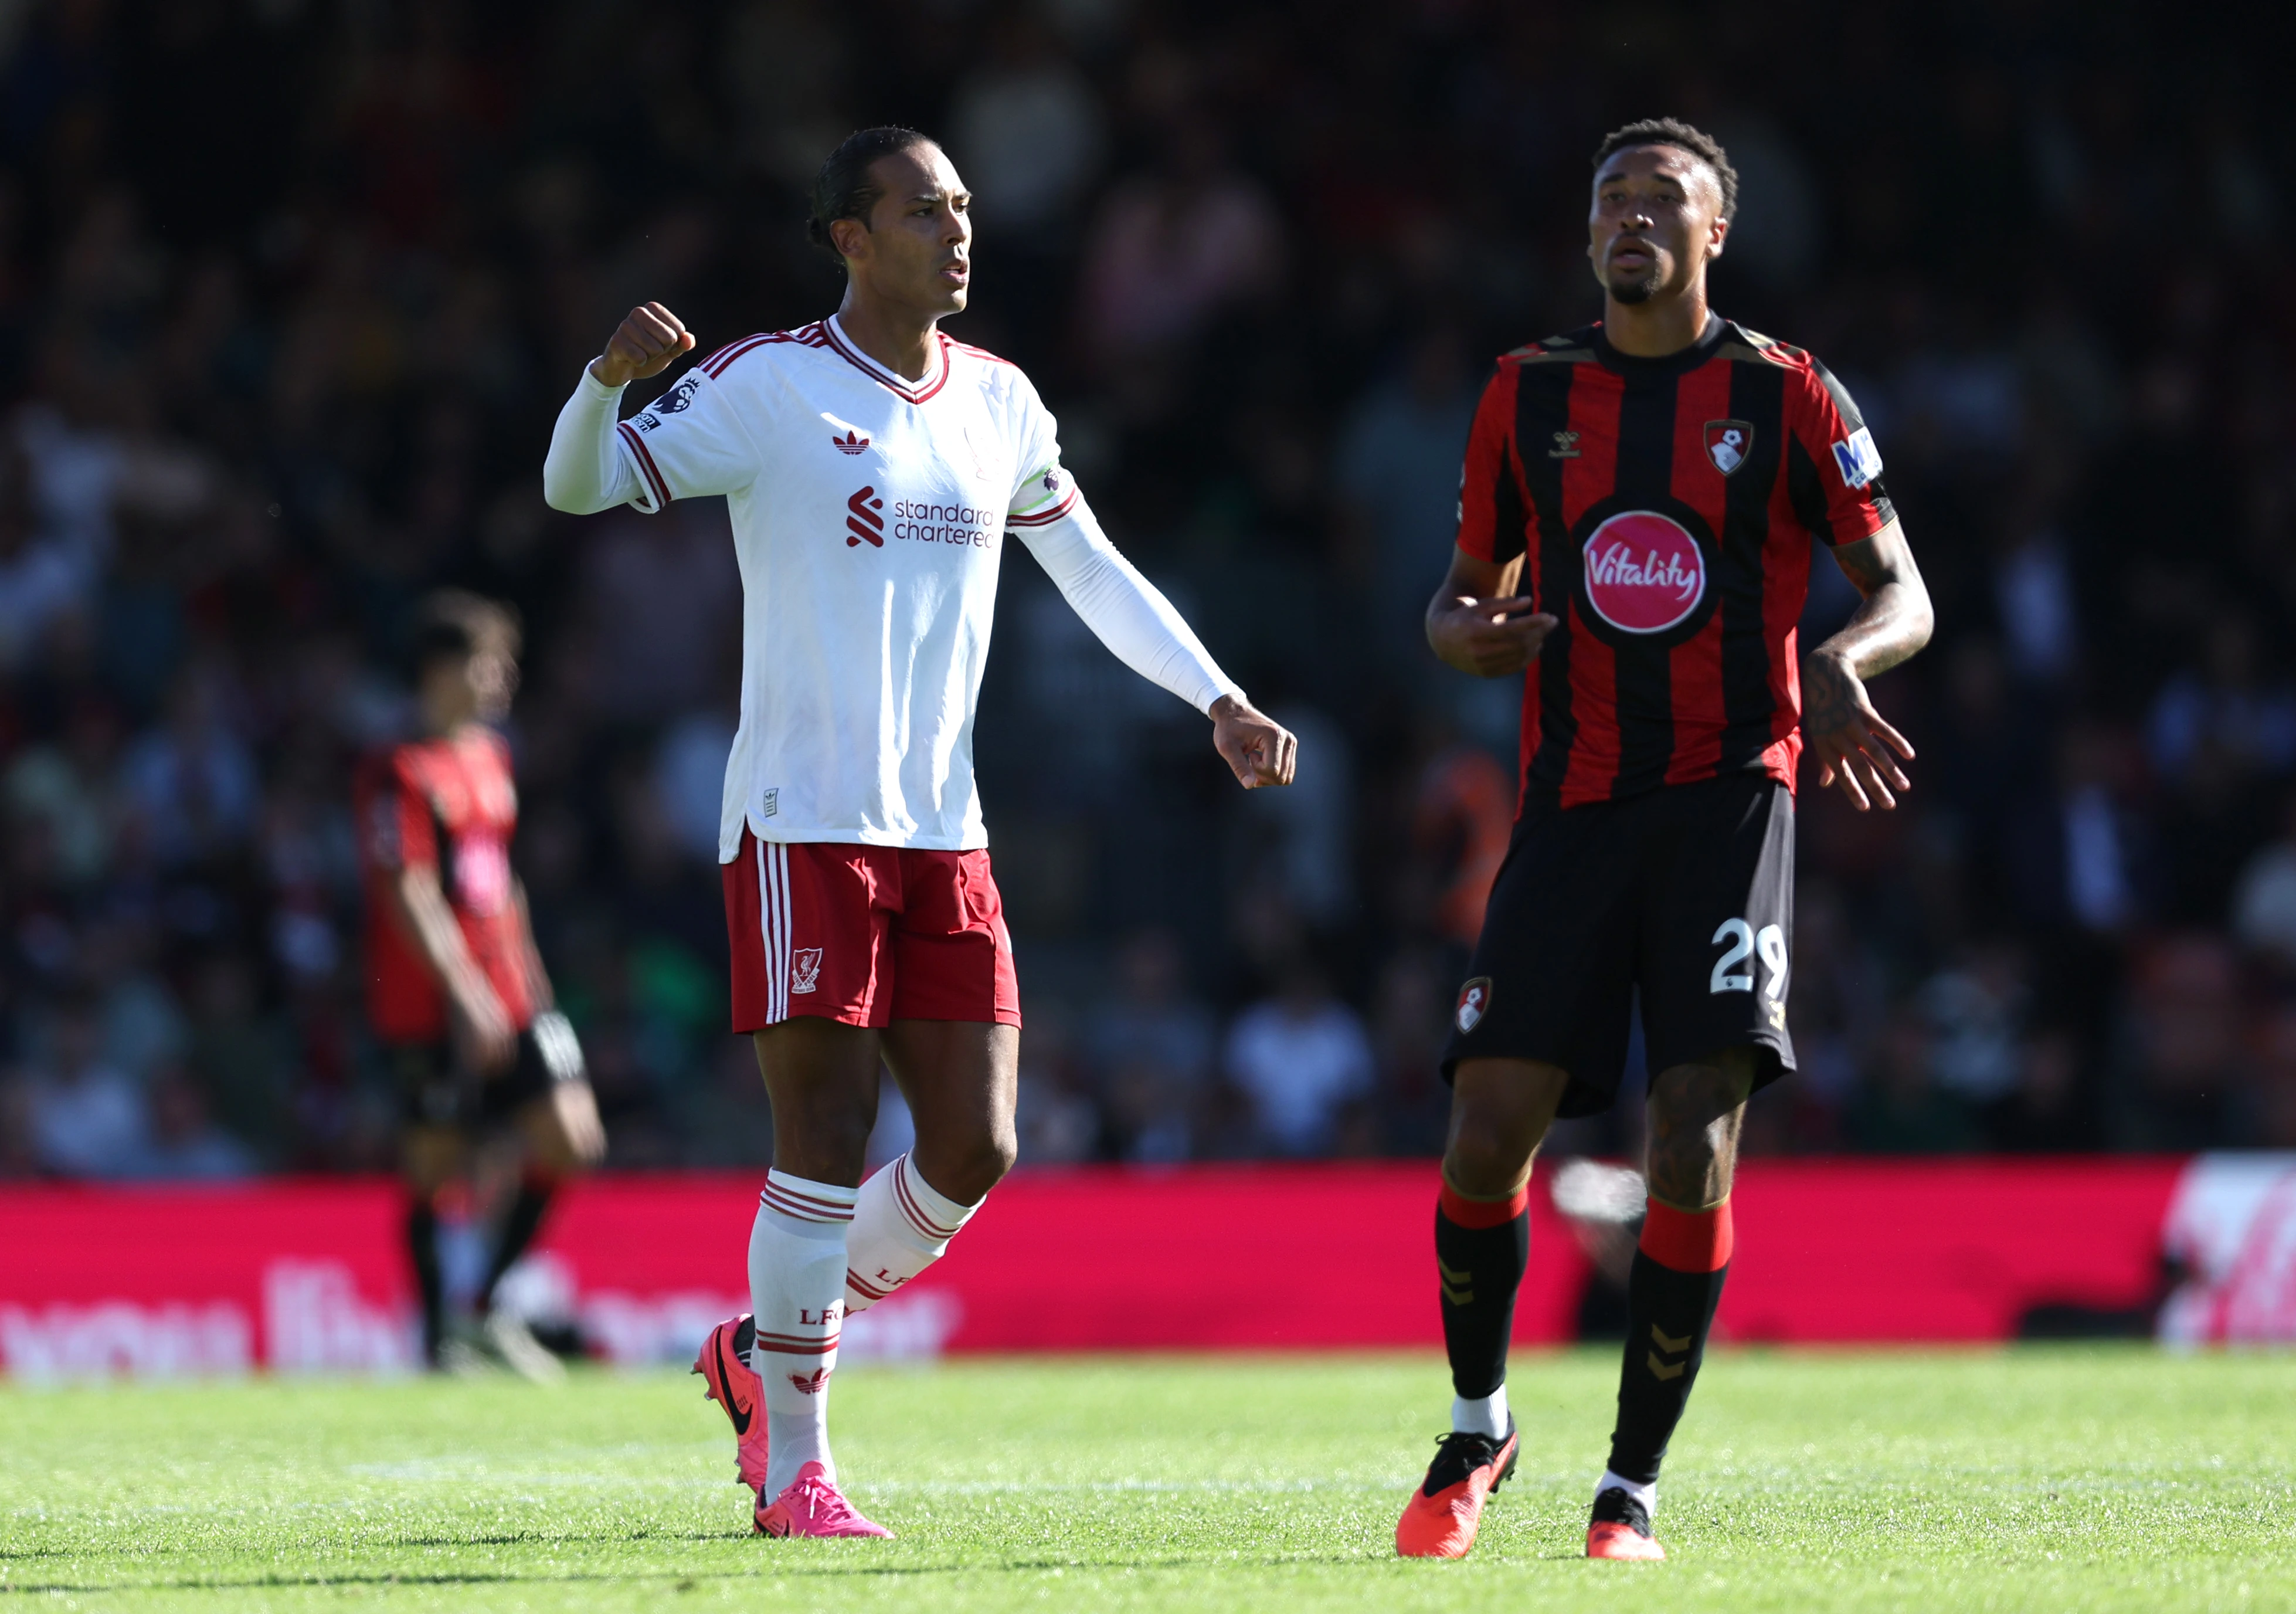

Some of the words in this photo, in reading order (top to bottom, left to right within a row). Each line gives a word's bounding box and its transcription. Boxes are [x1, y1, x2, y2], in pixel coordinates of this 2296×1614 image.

[1835, 433, 1871, 480] Mr
[895, 499, 993, 527] standard
[1589, 541, 1696, 601] Vitality
[1710, 917, 1788, 999] 29
[875, 1268, 910, 1285] LF
